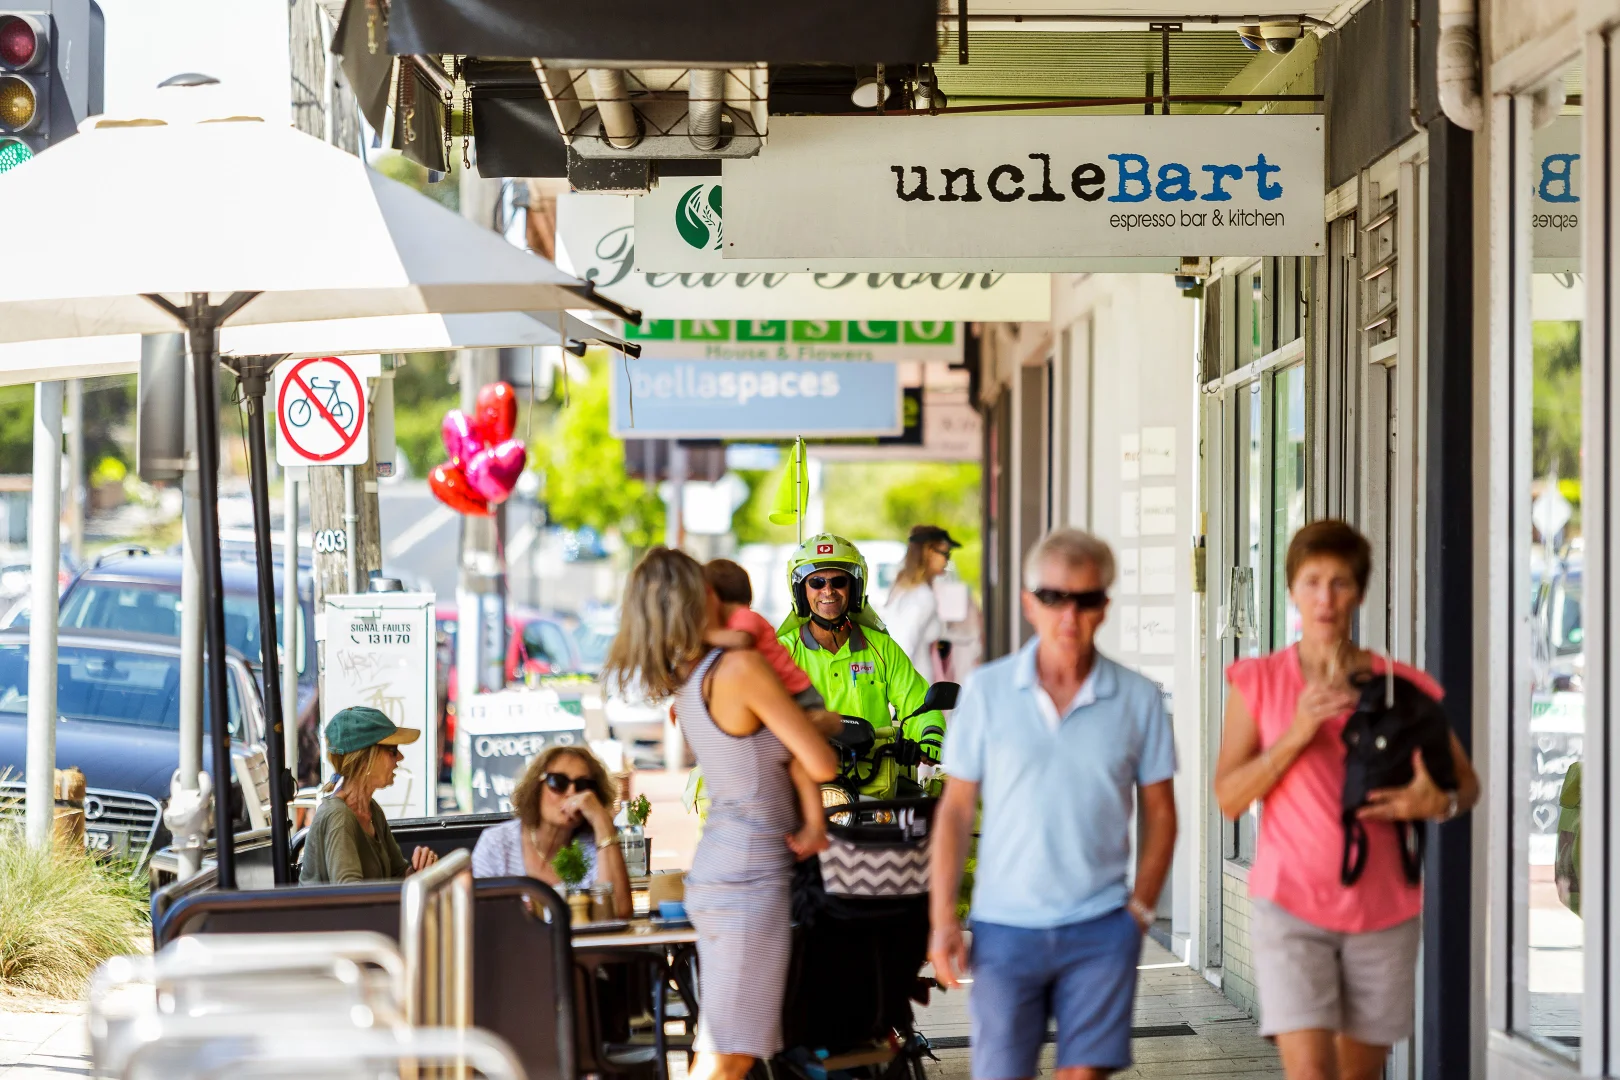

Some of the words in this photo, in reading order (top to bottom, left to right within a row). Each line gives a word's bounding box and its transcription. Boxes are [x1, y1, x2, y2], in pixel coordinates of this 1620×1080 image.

[890, 153, 1284, 203] uncleBart
[1109, 211, 1176, 231] espresso
[1179, 209, 1208, 227] bar
[1211, 210, 1225, 227] &
[1228, 209, 1285, 227] kitchen
[632, 365, 841, 405] bellaspaces
[315, 529, 346, 553] 603
[351, 623, 380, 633] SIGNAL
[382, 623, 411, 633] FAULTS
[368, 634, 381, 645] 13
[395, 634, 410, 645] 70
[475, 735, 545, 757] ORDER
